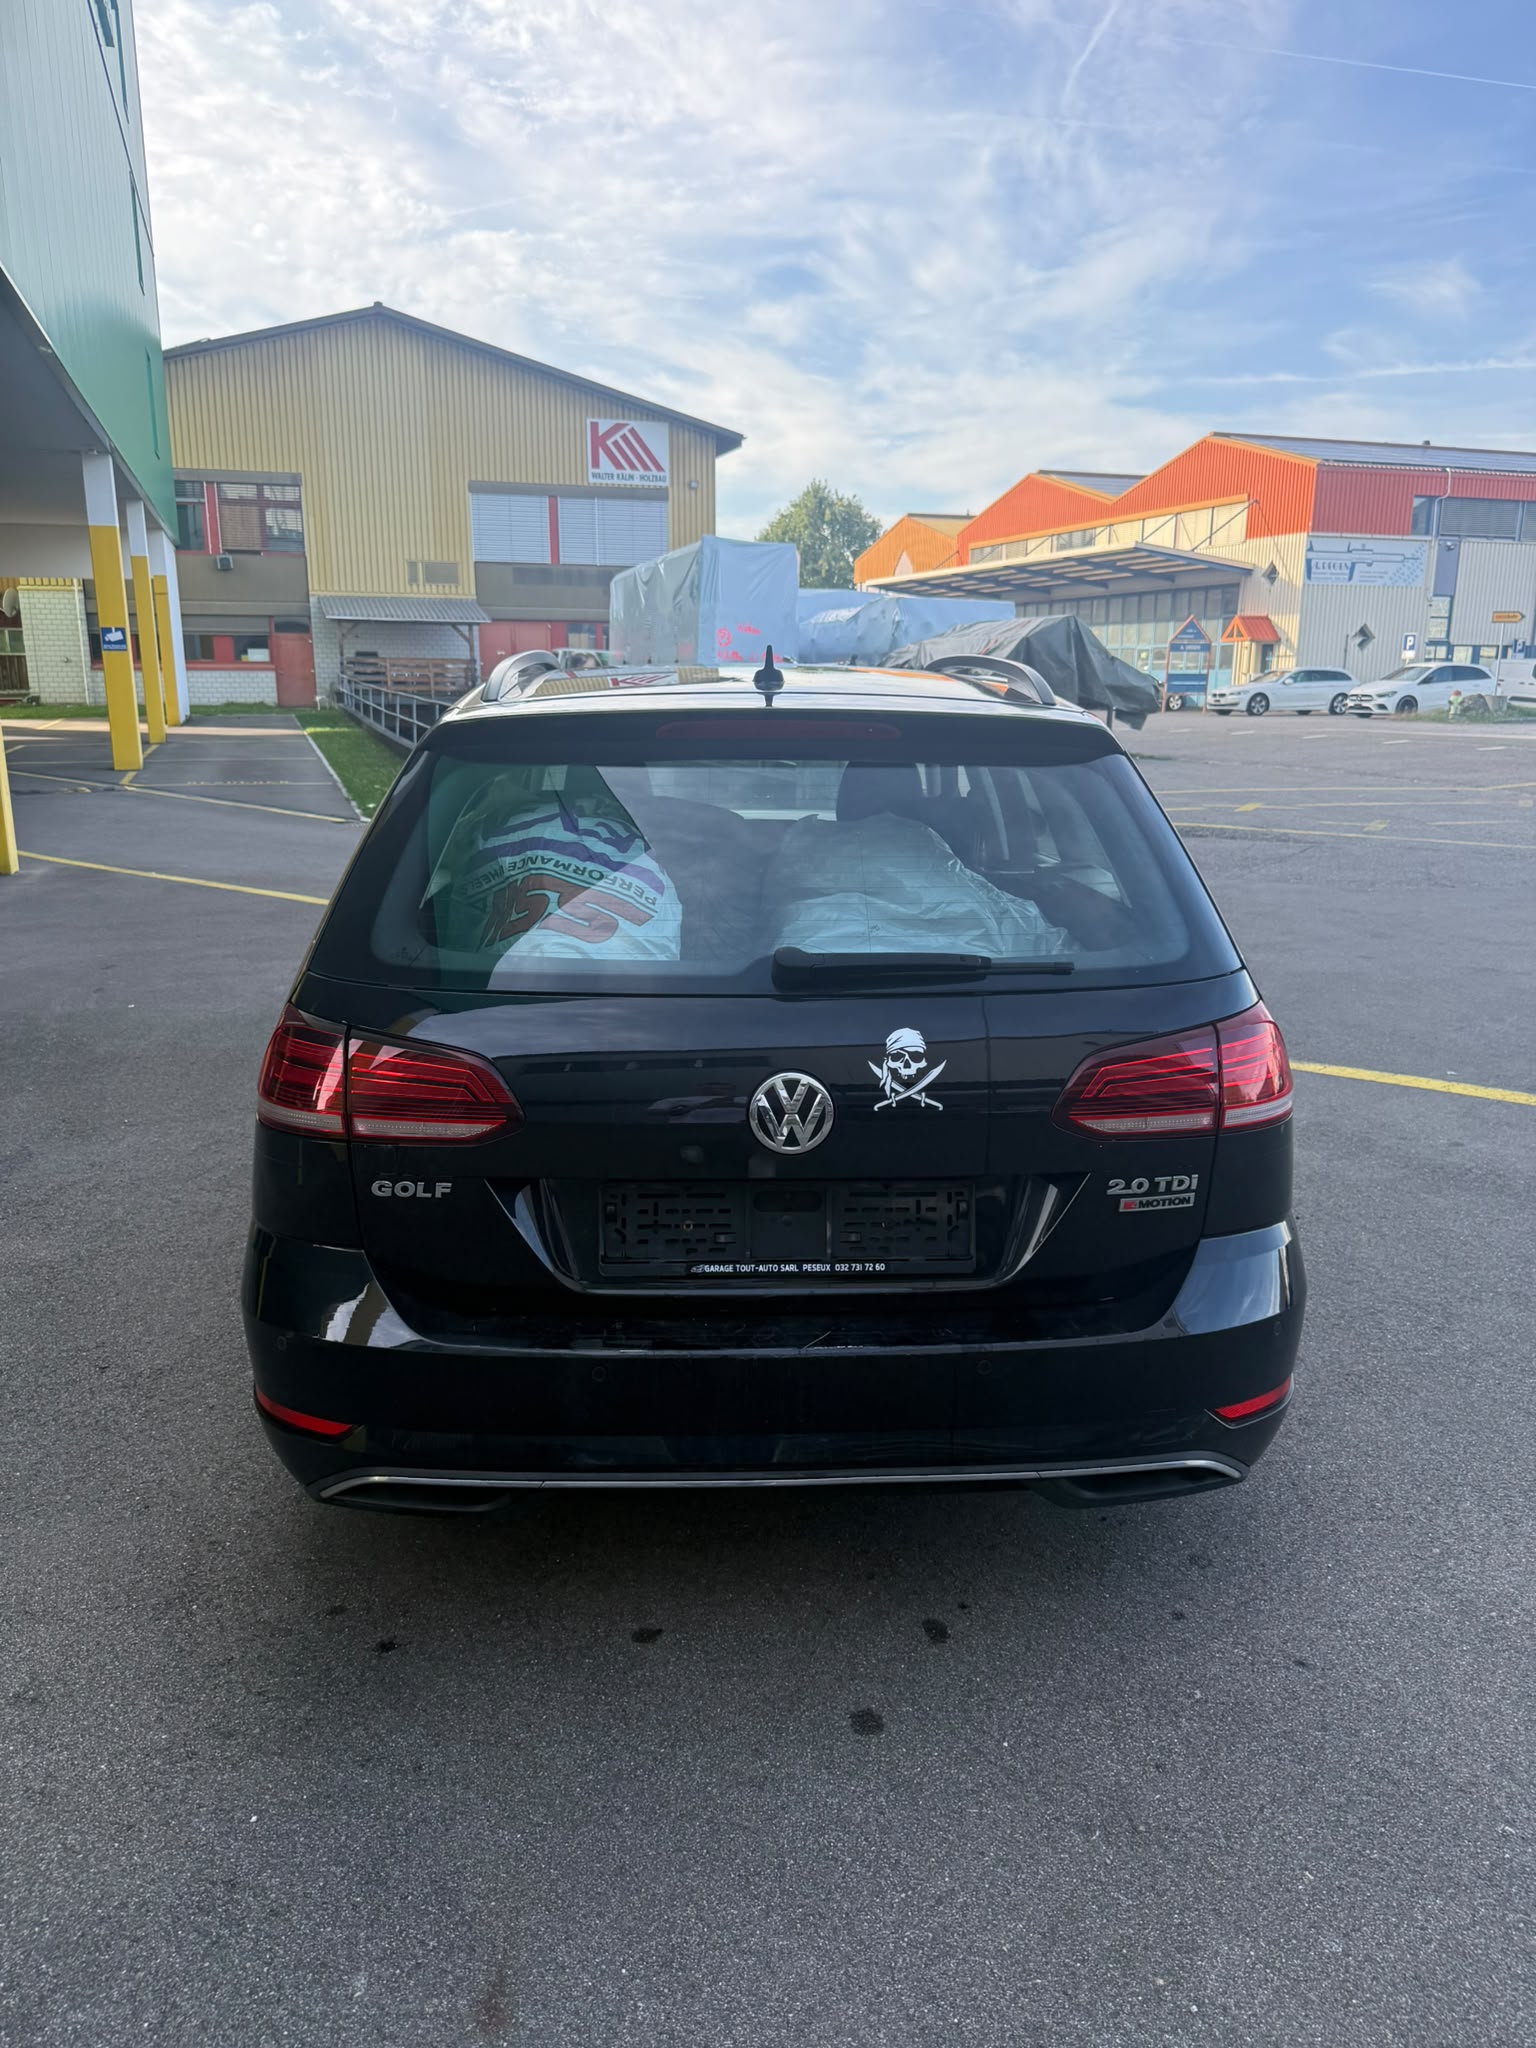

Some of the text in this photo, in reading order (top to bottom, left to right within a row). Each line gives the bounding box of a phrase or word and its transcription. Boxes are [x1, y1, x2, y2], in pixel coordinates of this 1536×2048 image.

[591, 472, 615, 481] WALTER
[507, 855, 658, 906] PERFORMANCE
[371, 1180, 453, 1198] GOLF
[704, 1264, 733, 1272] GARAGE
[736, 1264, 779, 1272] TOUT-AUTO
[780, 1264, 799, 1272] SARL
[875, 1263, 886, 1271] 60
